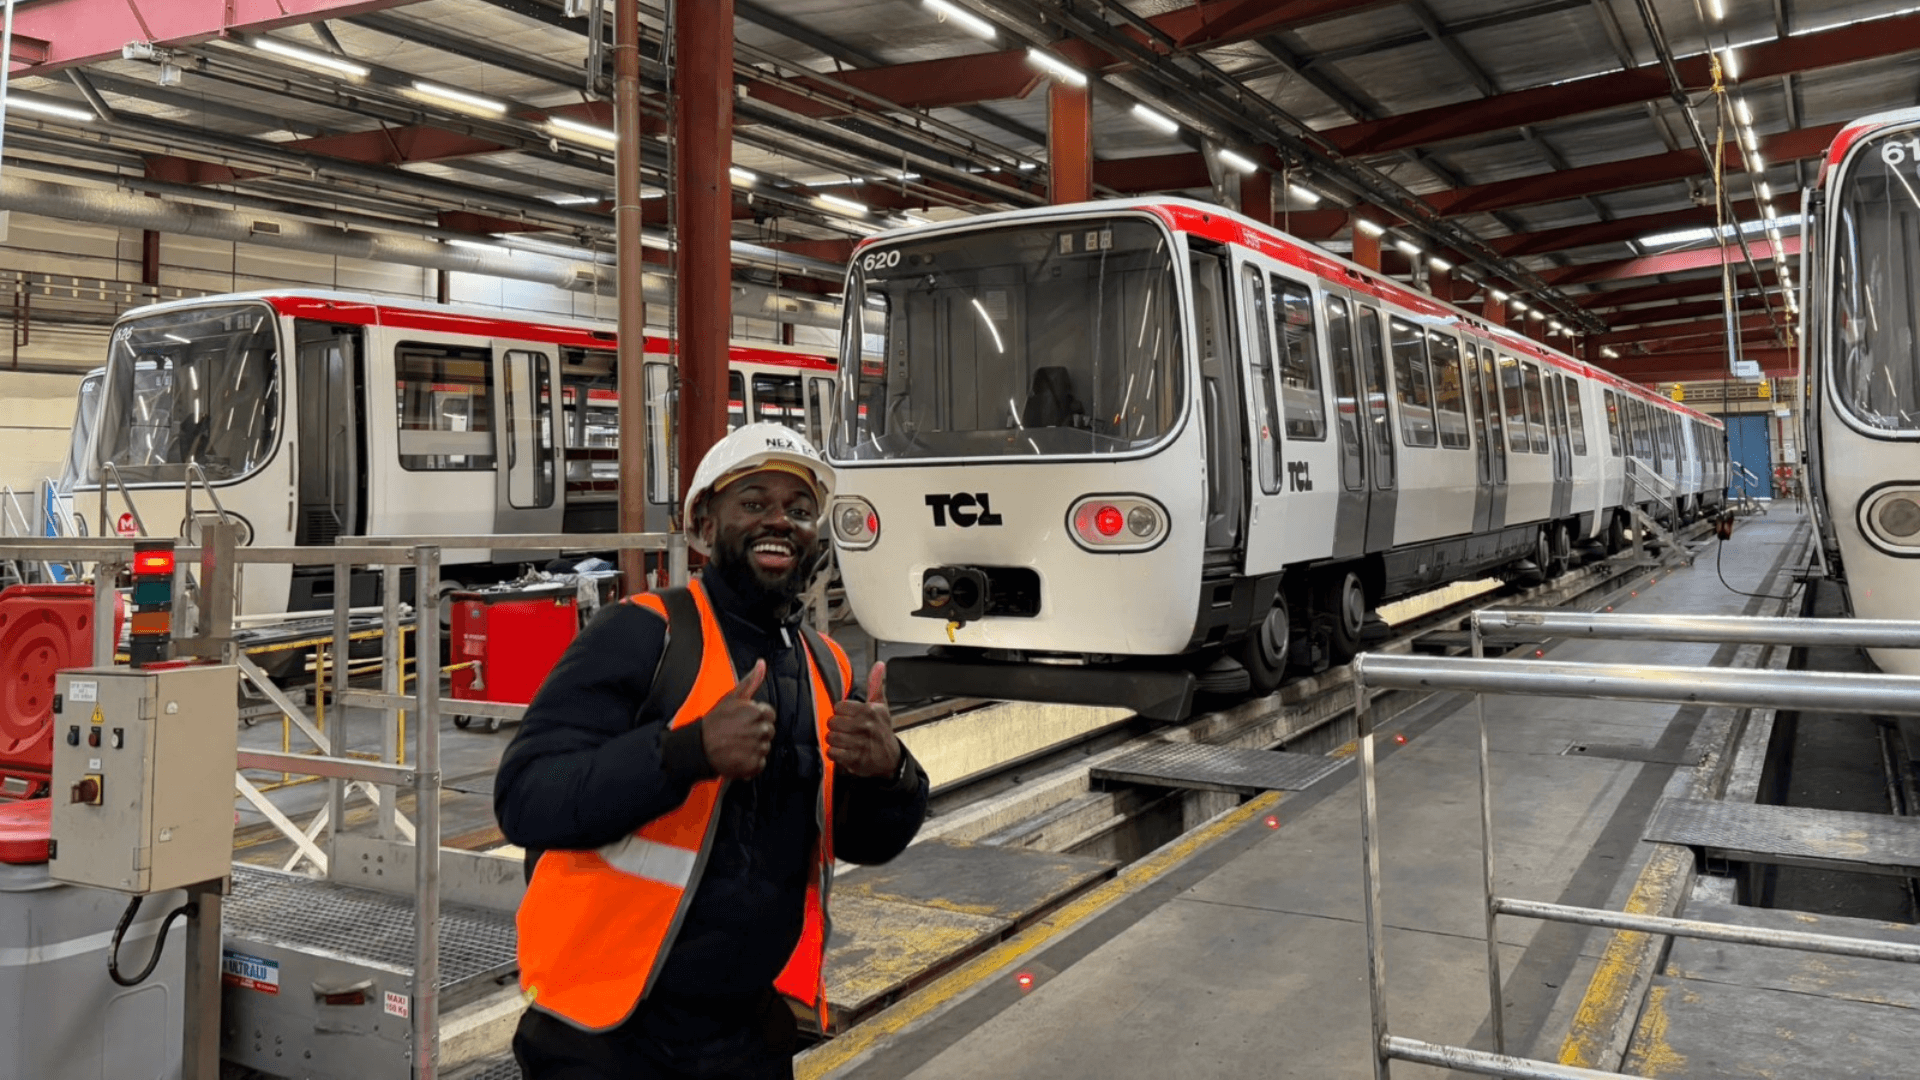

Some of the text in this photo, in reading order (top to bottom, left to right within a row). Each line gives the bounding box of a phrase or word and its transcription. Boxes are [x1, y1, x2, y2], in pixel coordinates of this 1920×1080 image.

[863, 250, 901, 271] 620
[1287, 460, 1313, 492] TCL
[925, 492, 1003, 527] TCL
[120, 517, 134, 530] M
[229, 960, 268, 980] ULTRALU
[387, 993, 406, 1005] MAXI
